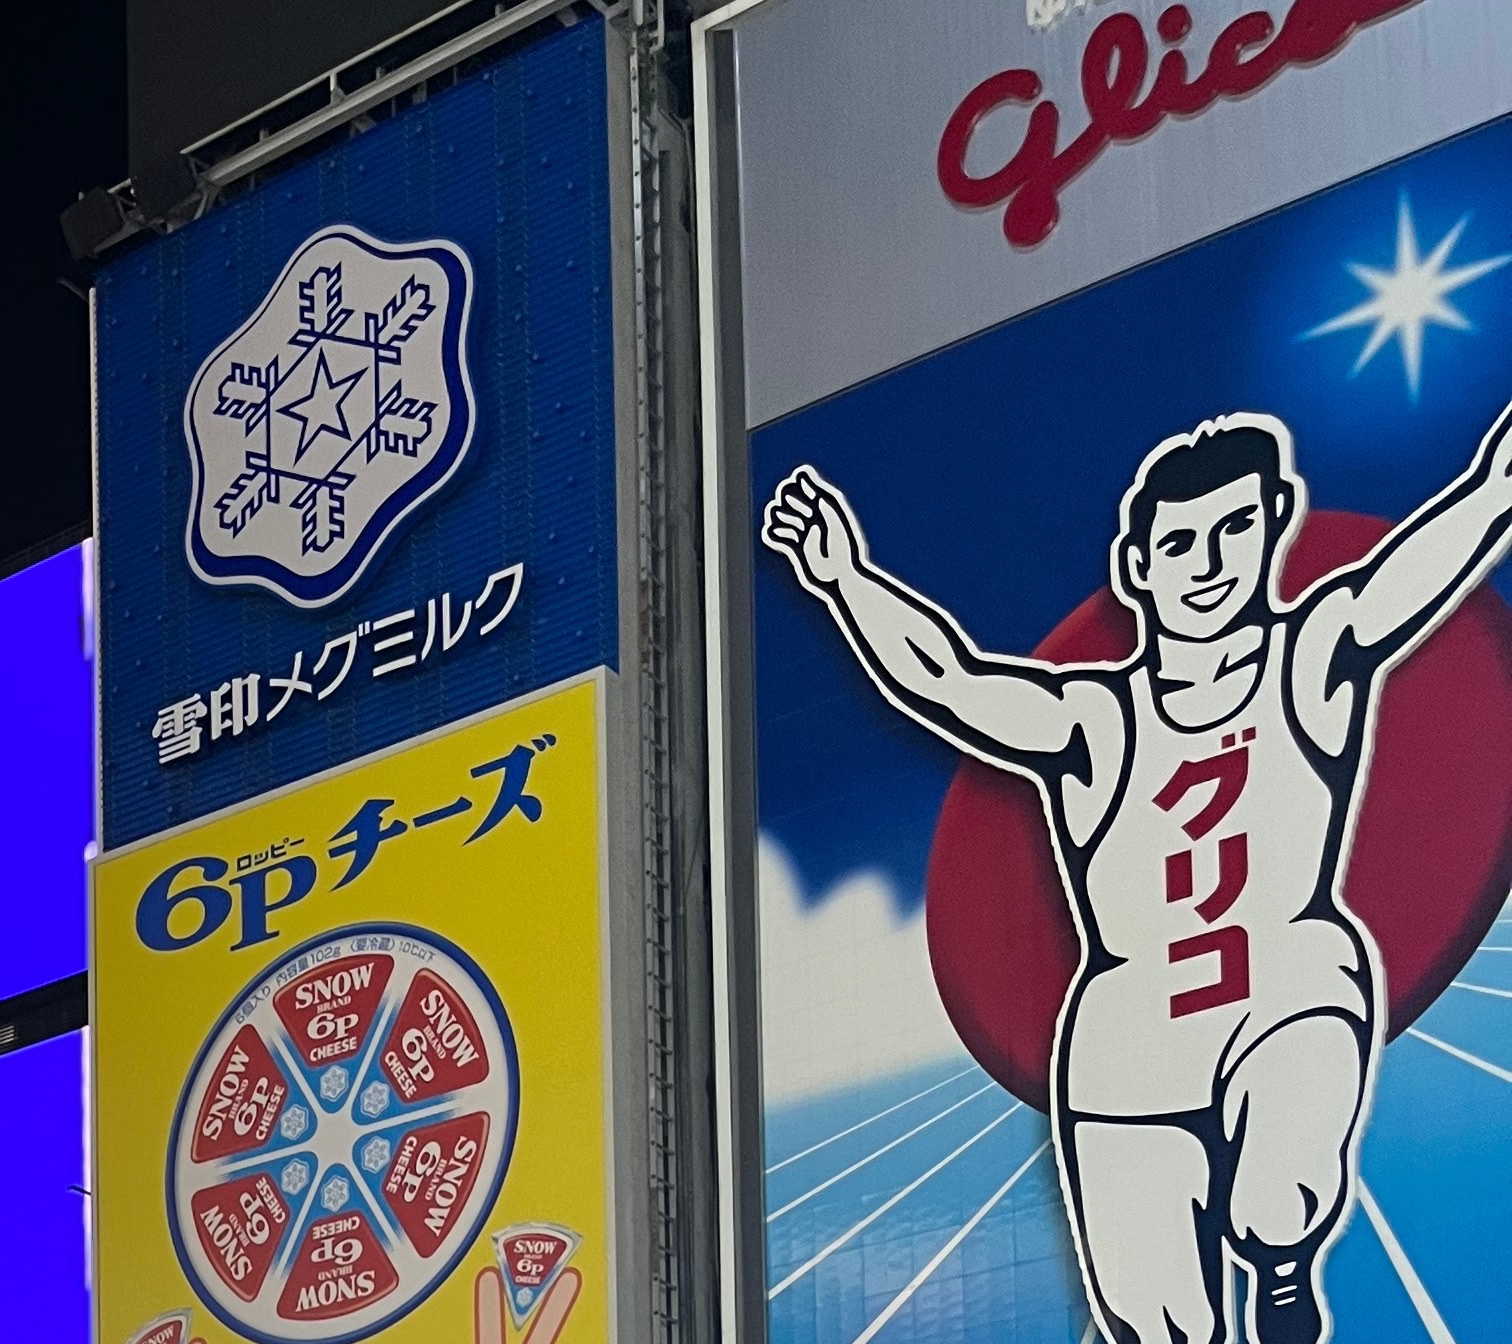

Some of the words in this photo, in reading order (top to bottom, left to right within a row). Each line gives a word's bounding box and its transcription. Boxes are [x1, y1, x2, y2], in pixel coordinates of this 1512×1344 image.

[151, 562, 524, 766] 雪印メグミルク
[236, 837, 305, 872] ロッピー
[1151, 726, 1258, 1020] グリコ
[295, 962, 375, 1010] SNOW
[316, 995, 352, 1014] BRAND
[309, 1036, 358, 1062] CHEESE
[420, 989, 479, 1068] SNOW
[202, 1044, 250, 1141] SNOW
[384, 1051, 417, 1099] CHEESE
[255, 1085, 285, 1140] CHEESE
[386, 1136, 418, 1194] CHEESE
[424, 1136, 477, 1237] SNOW
[255, 1177, 286, 1224] CHEESE
[200, 1205, 252, 1281] SNOW
[313, 1215, 361, 1240] CHEESE
[513, 1240, 558, 1255] SNOW
[295, 1270, 376, 1312] SNOW
